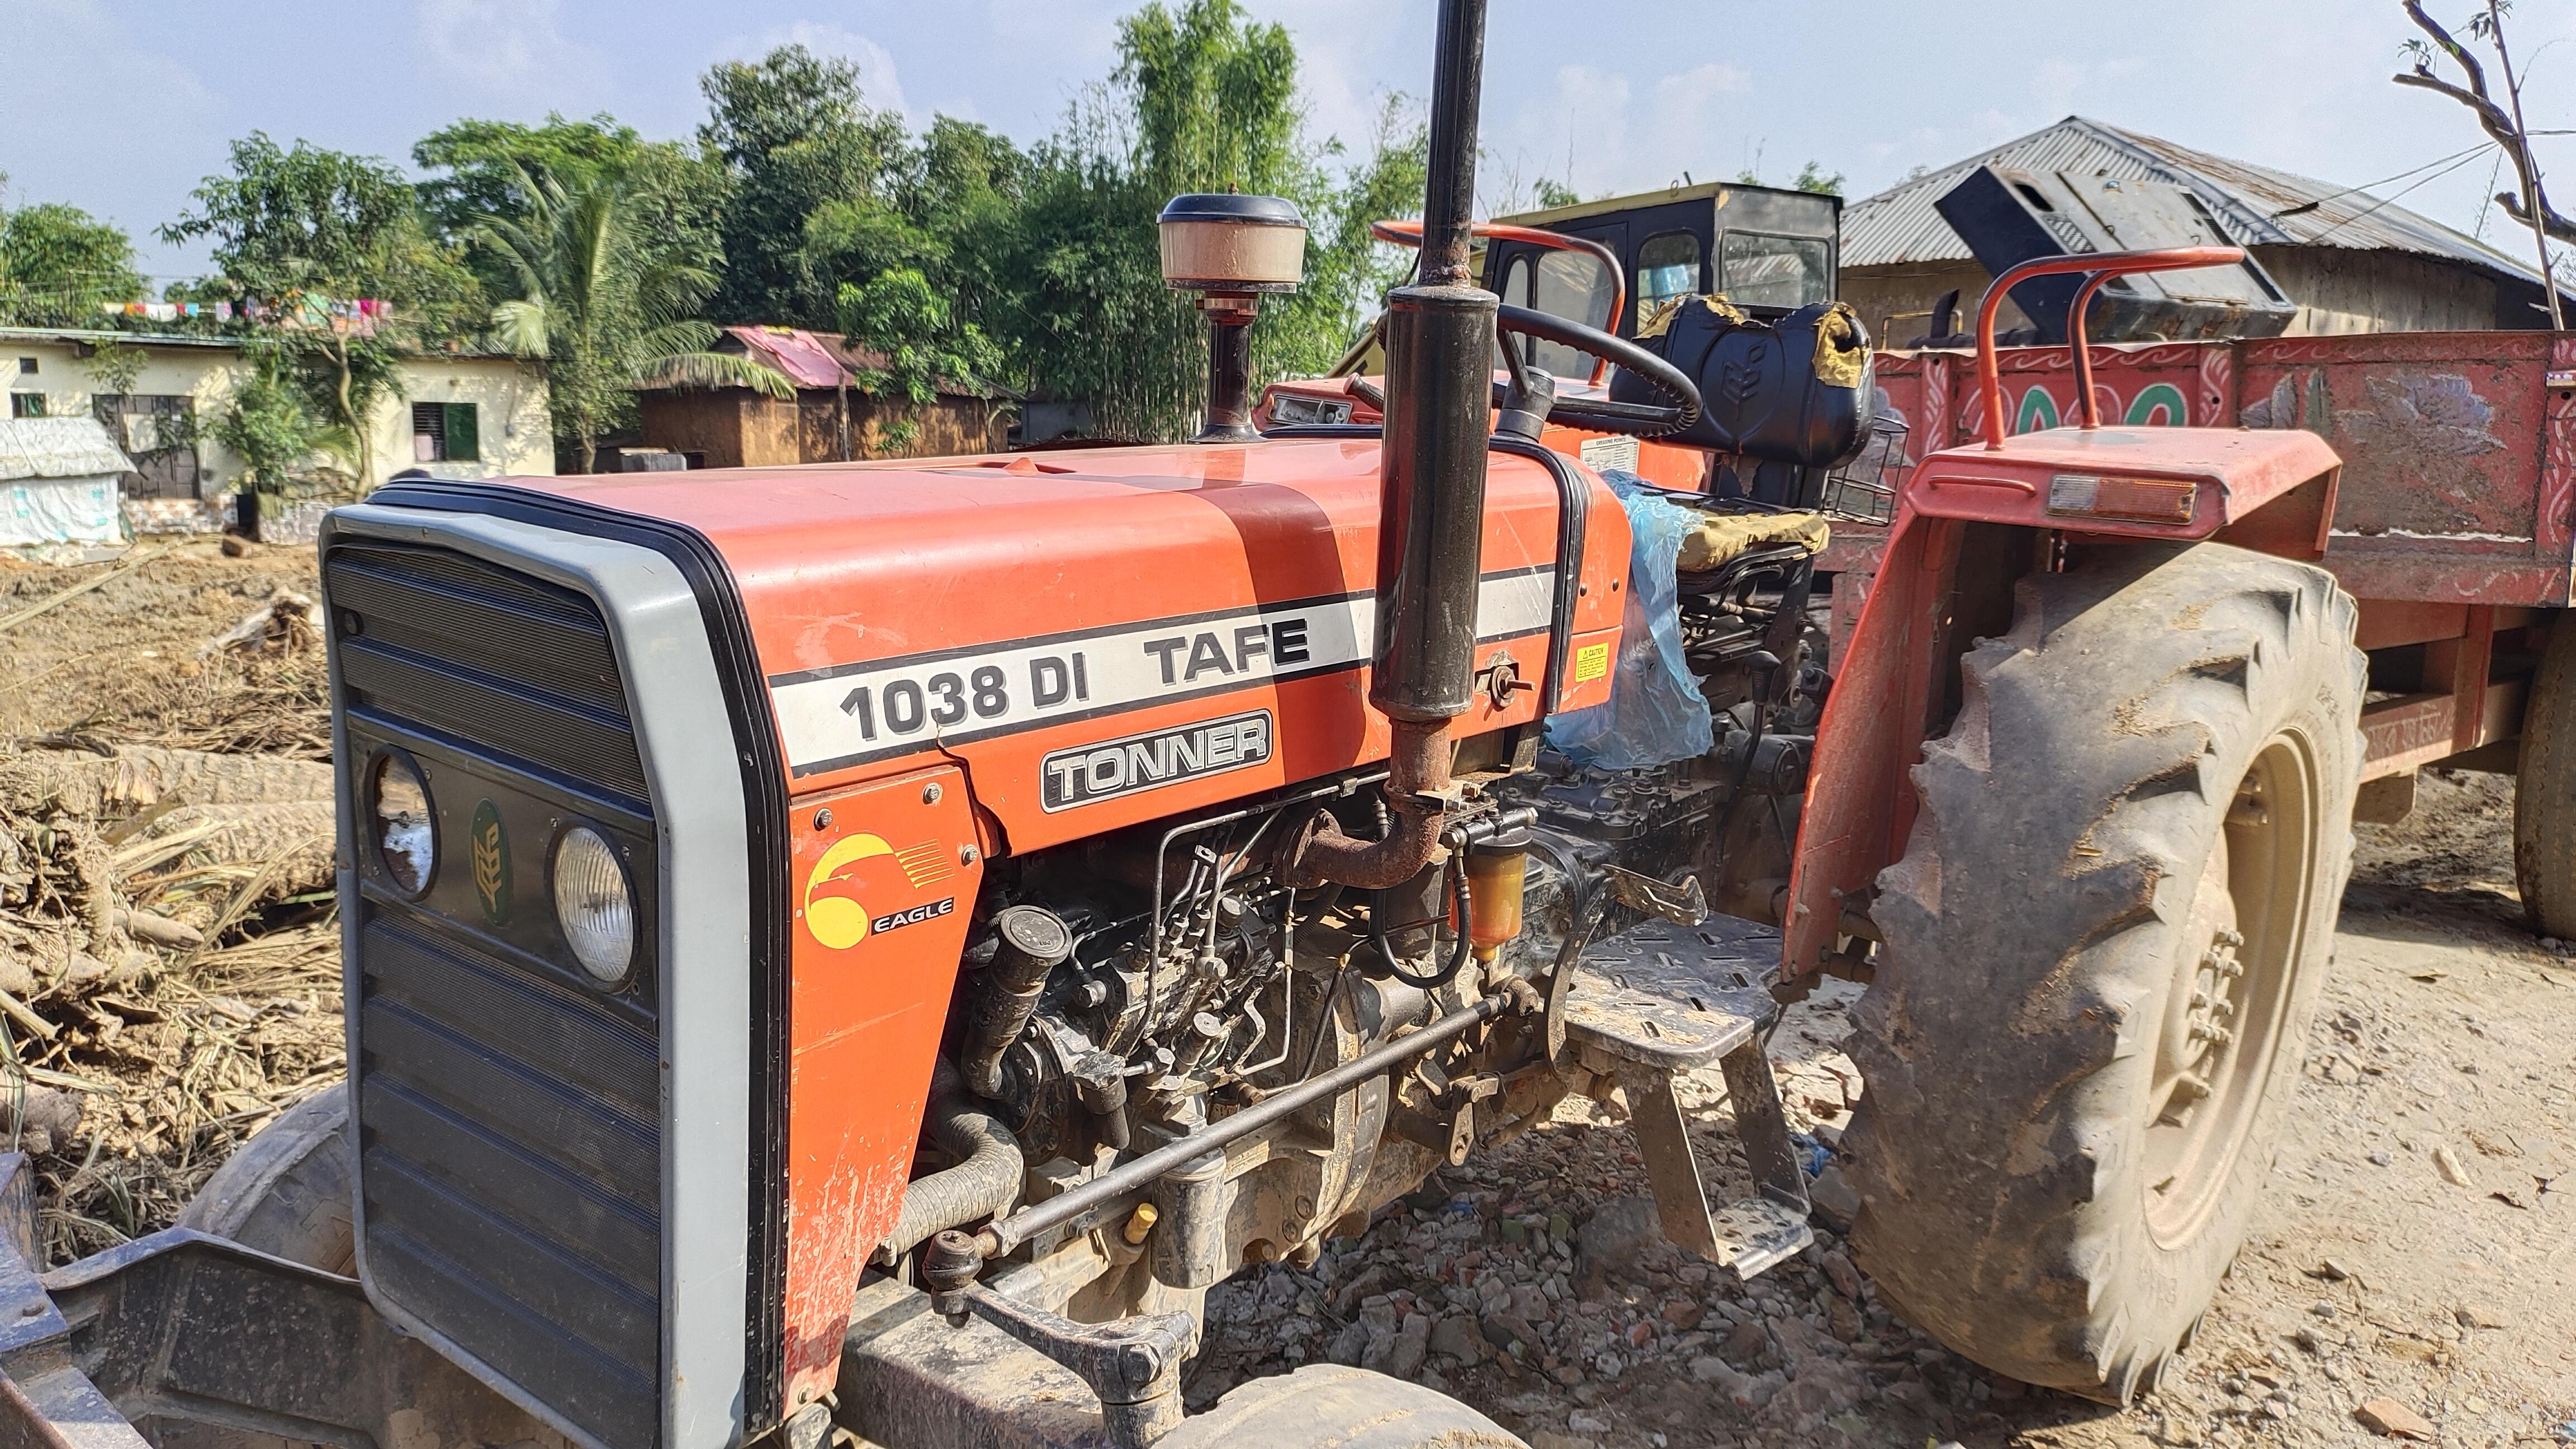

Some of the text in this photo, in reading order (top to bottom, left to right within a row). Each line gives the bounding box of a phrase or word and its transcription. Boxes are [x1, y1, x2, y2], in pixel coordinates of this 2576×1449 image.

[840, 618, 1310, 741] 1038 DI TAFE
[1589, 647, 1604, 657] CAUTION
[1048, 718, 1267, 802] TONNER
[874, 899, 953, 932] EAGLE
